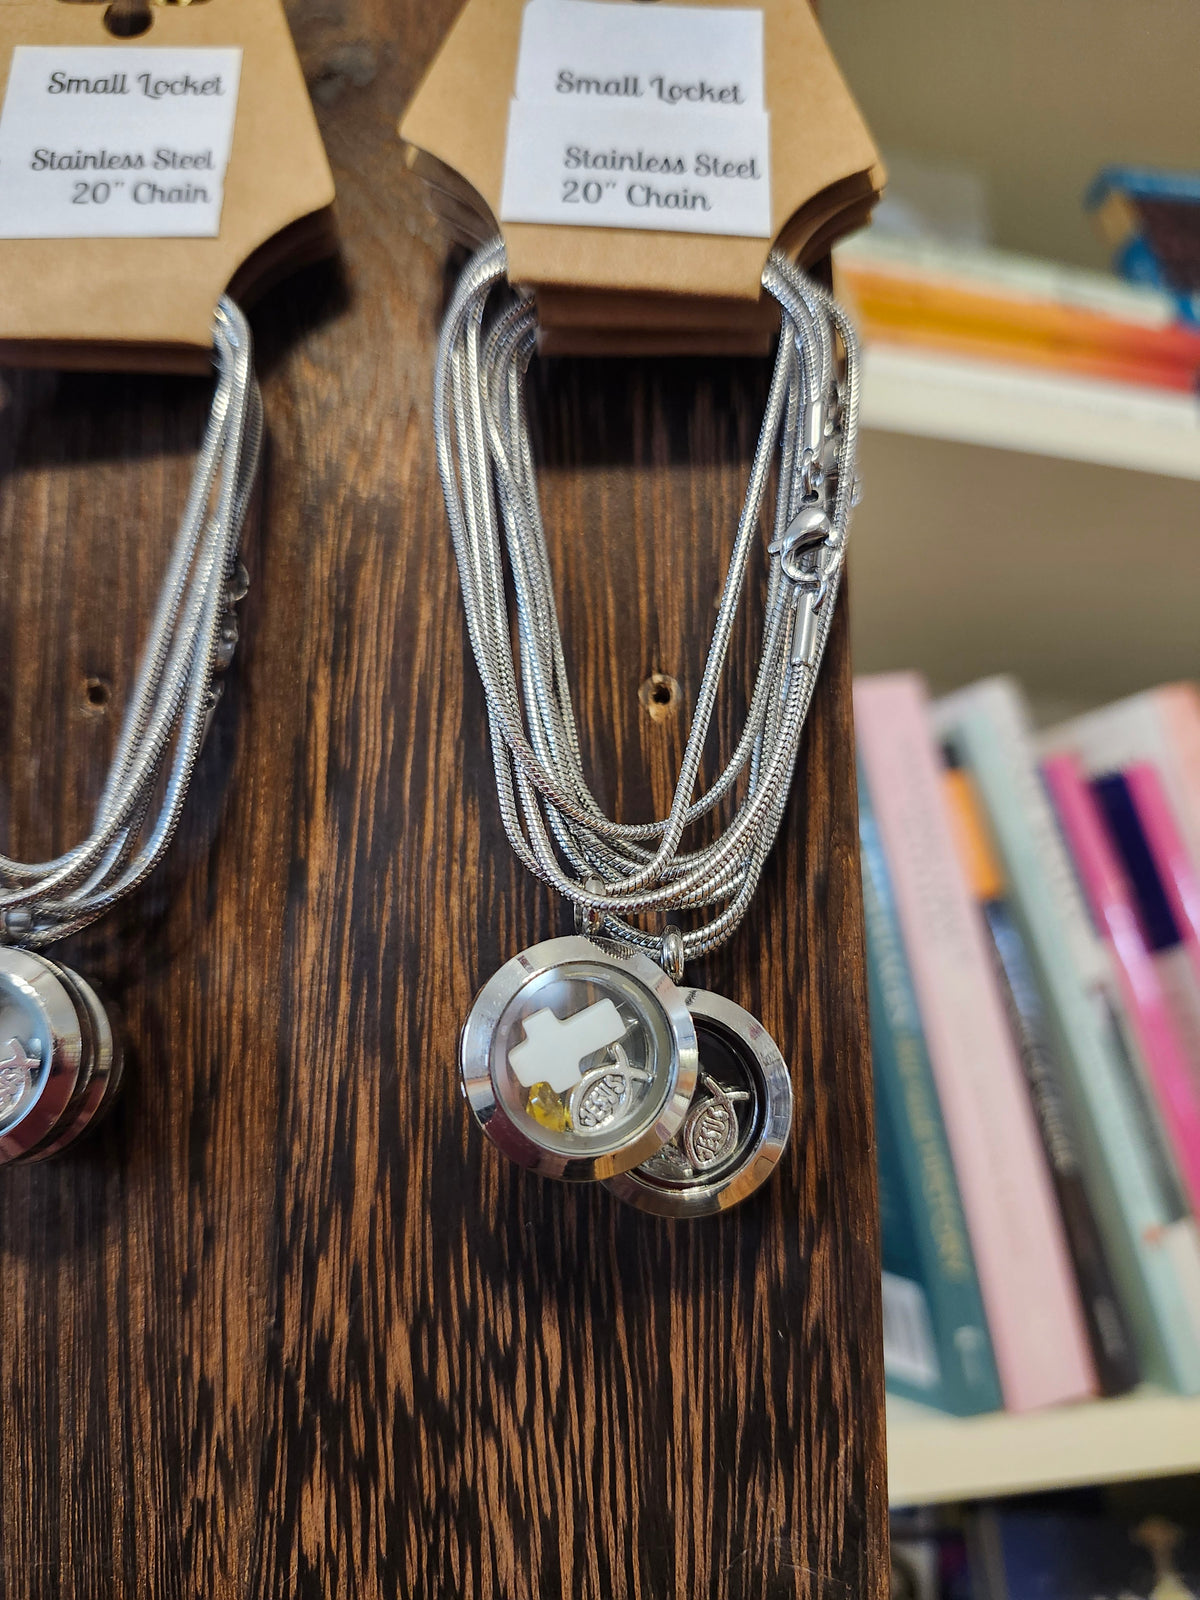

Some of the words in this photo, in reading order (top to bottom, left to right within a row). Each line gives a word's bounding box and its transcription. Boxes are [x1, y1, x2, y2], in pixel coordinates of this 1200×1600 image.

[47, 71, 130, 95] Small
[136, 73, 224, 98] Locket
[555, 70, 643, 97] Small
[649, 75, 745, 105] Locket
[31, 148, 145, 171] Stainless
[152, 149, 215, 171] Steel
[563, 146, 687, 175] Stainless
[693, 153, 761, 180] Steel
[132, 183, 209, 204] Chain
[626, 183, 712, 211] Chain
[579, 1074, 626, 1127] JESUS
[696, 1106, 729, 1160] JESUS
